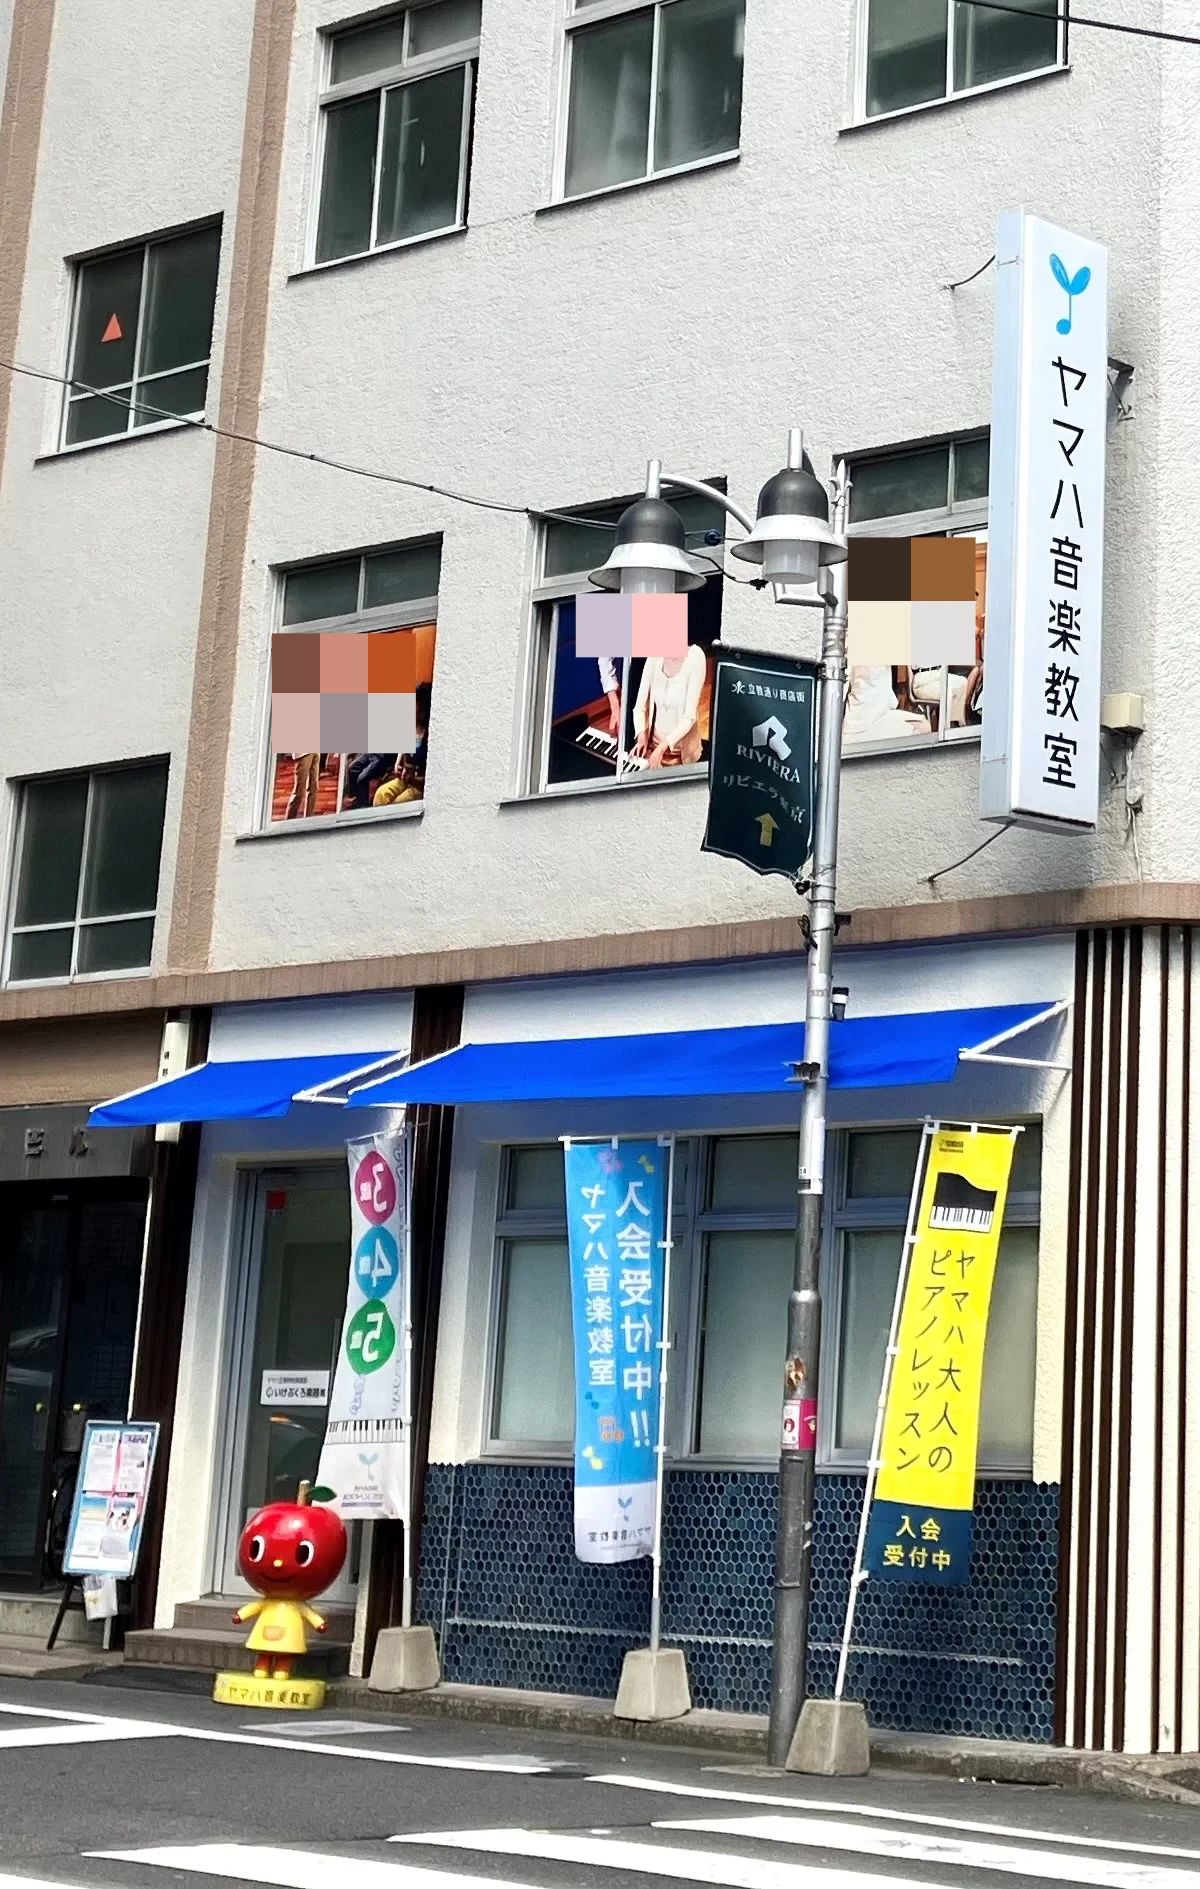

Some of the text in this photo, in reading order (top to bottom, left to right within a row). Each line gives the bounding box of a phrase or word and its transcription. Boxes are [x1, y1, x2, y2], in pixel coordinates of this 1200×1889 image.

[1043, 356, 1087, 788] ヤマハ音楽教室
[737, 744, 801, 784] RIVIERA
[896, 1249, 952, 1471] ピアノレッスン
[928, 1254, 975, 1472] ヤマハ大人の
[883, 1543, 951, 1571] 受付中
[896, 1515, 942, 1542] 入会
